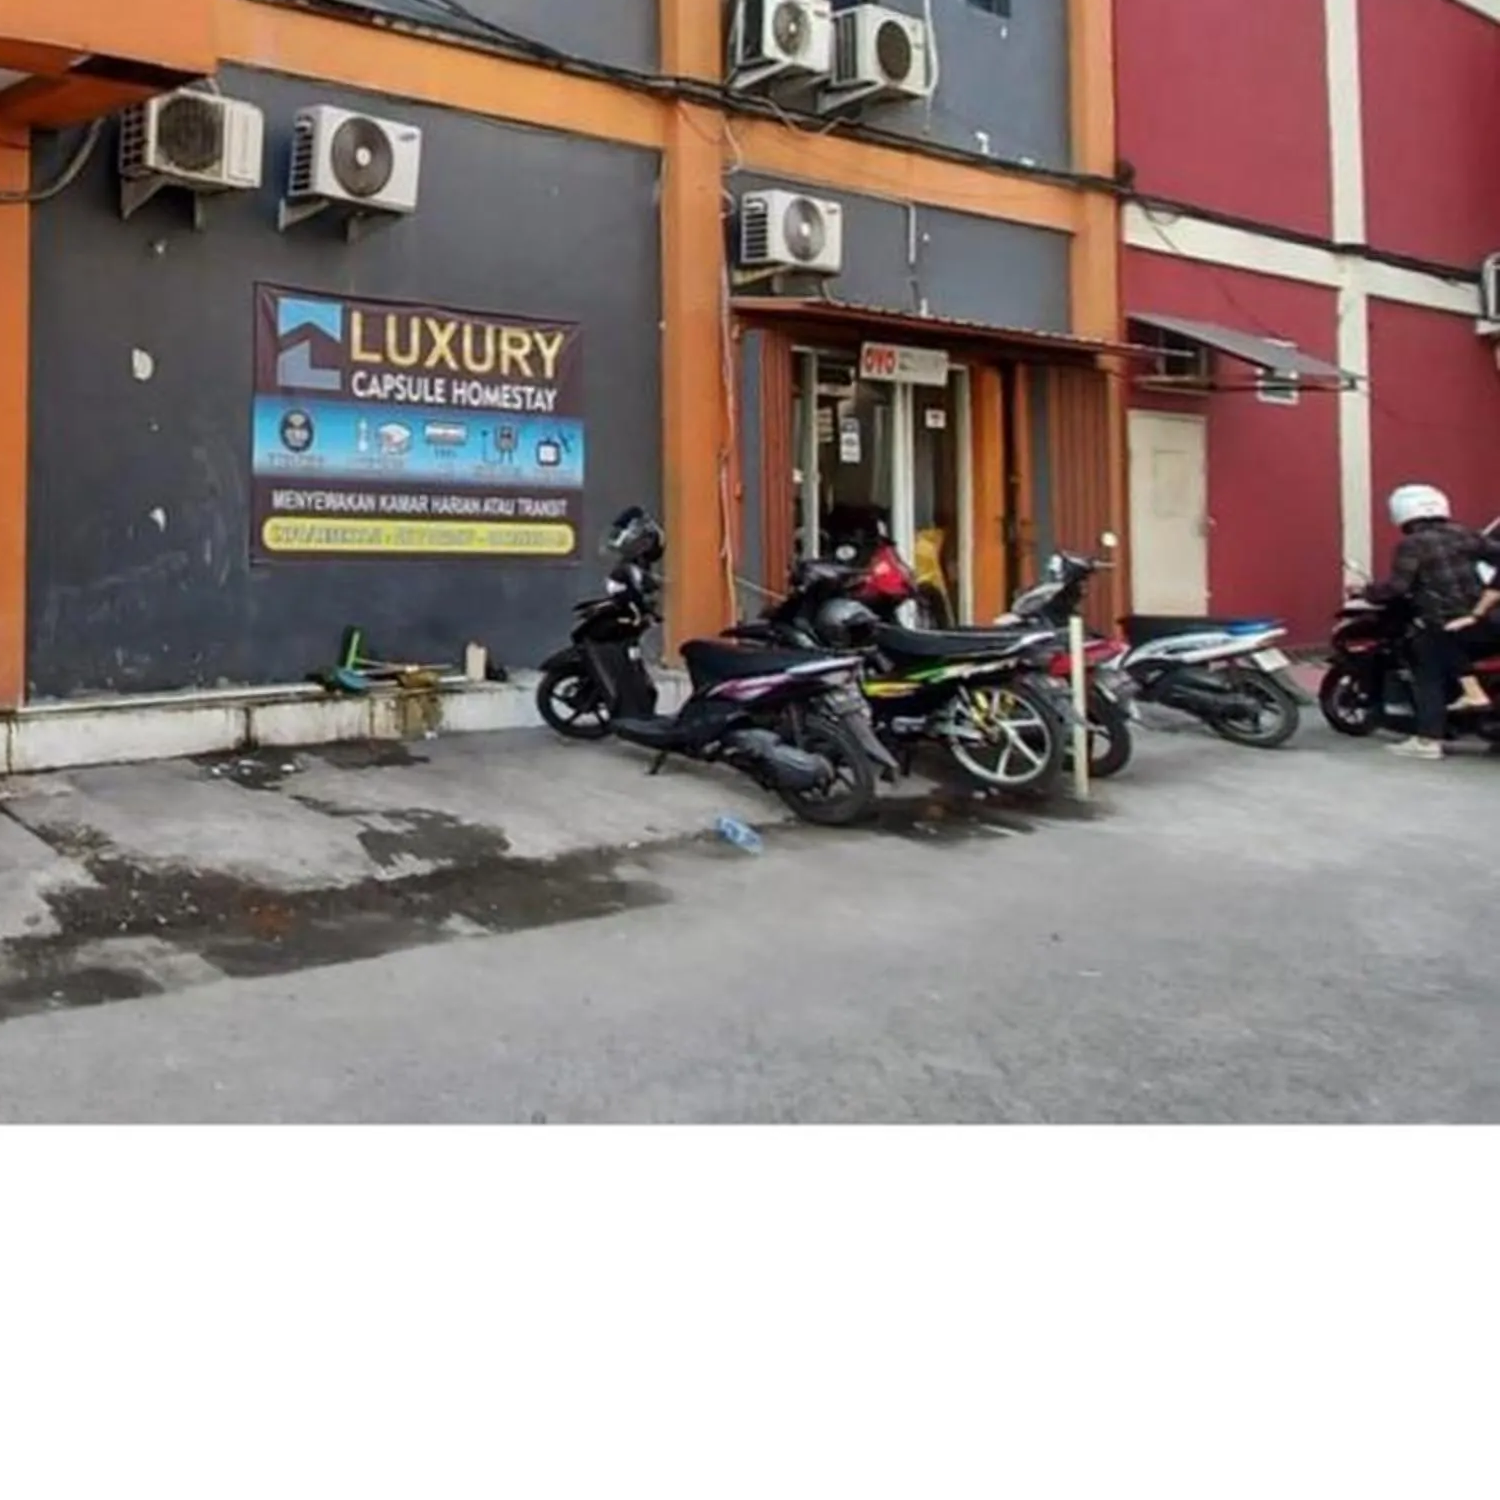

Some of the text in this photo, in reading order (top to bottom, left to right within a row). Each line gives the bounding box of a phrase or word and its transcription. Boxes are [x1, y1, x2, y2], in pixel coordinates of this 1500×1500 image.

[351, 310, 564, 380] LUXURY
[351, 371, 558, 413] CAPSULE HOMESTAY
[272, 489, 568, 517] MENYEWAKAN KAMAR HARIAN ATAU TRANSIT
